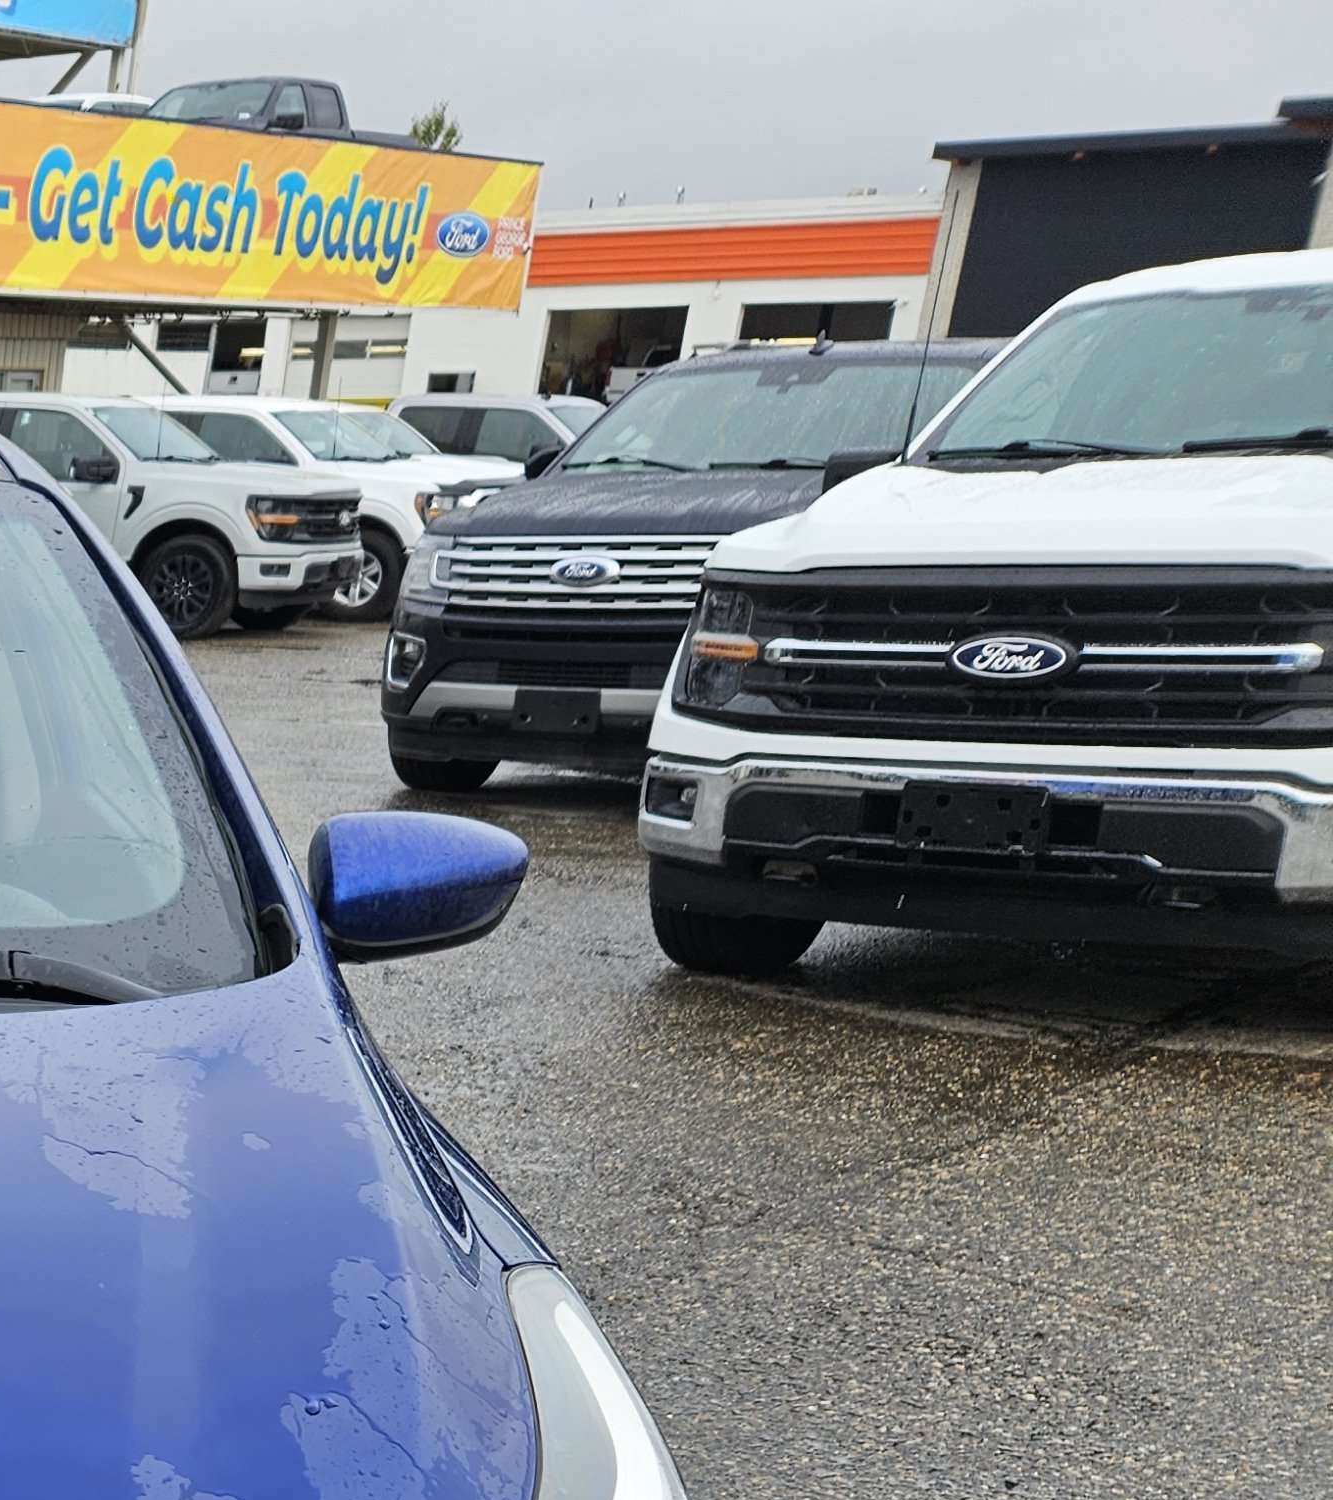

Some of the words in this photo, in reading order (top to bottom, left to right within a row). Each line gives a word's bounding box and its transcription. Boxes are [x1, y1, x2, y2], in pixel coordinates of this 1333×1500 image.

[33, 147, 121, 246] Get
[135, 158, 258, 255] Cash
[273, 170, 429, 285] Today!
[445, 219, 482, 252] Ford
[973, 642, 1045, 672] Ford
